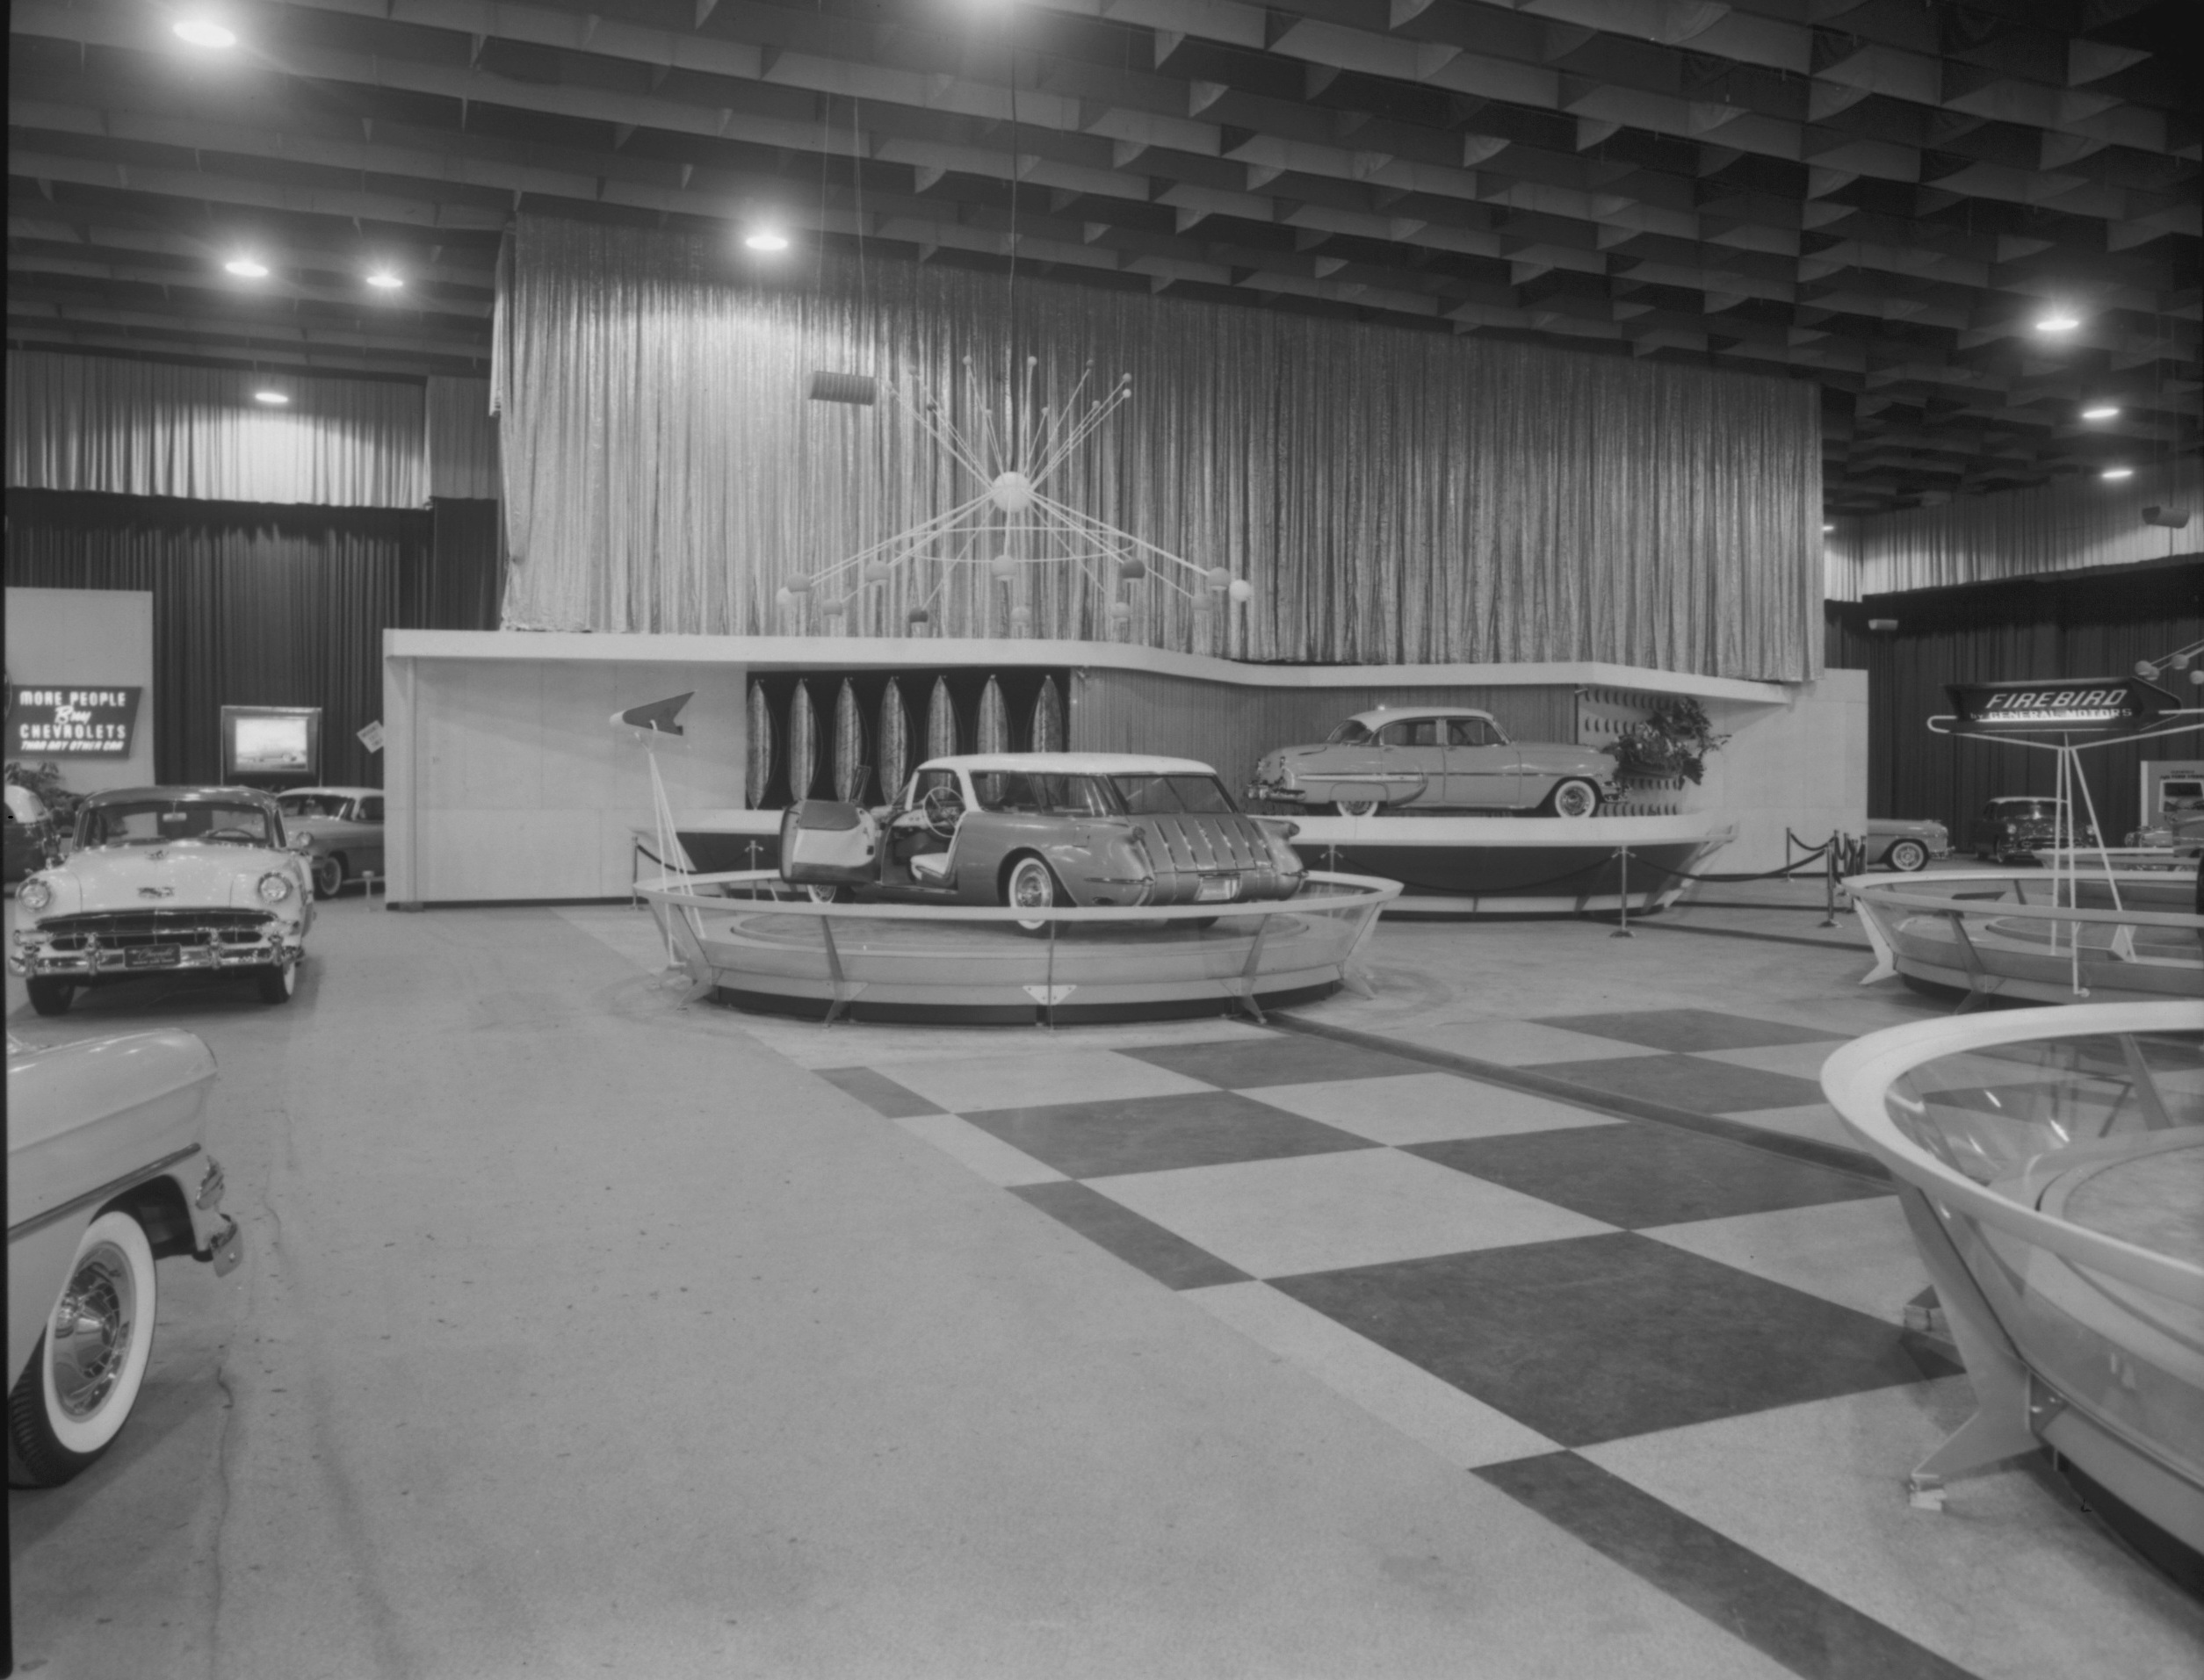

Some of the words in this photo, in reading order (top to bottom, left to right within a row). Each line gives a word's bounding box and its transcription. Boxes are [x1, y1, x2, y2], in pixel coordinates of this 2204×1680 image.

[19, 690, 62, 706] MORE
[69, 691, 126, 707] PEOPLE
[1985, 689, 2128, 709] FIREBIRD
[54, 705, 91, 725] Buy
[1988, 710, 2055, 720] GENERAL
[2065, 708, 2132, 719] MOTORS
[19, 724, 126, 739] CHEVROLETS
[69, 740, 102, 752] OTHER
